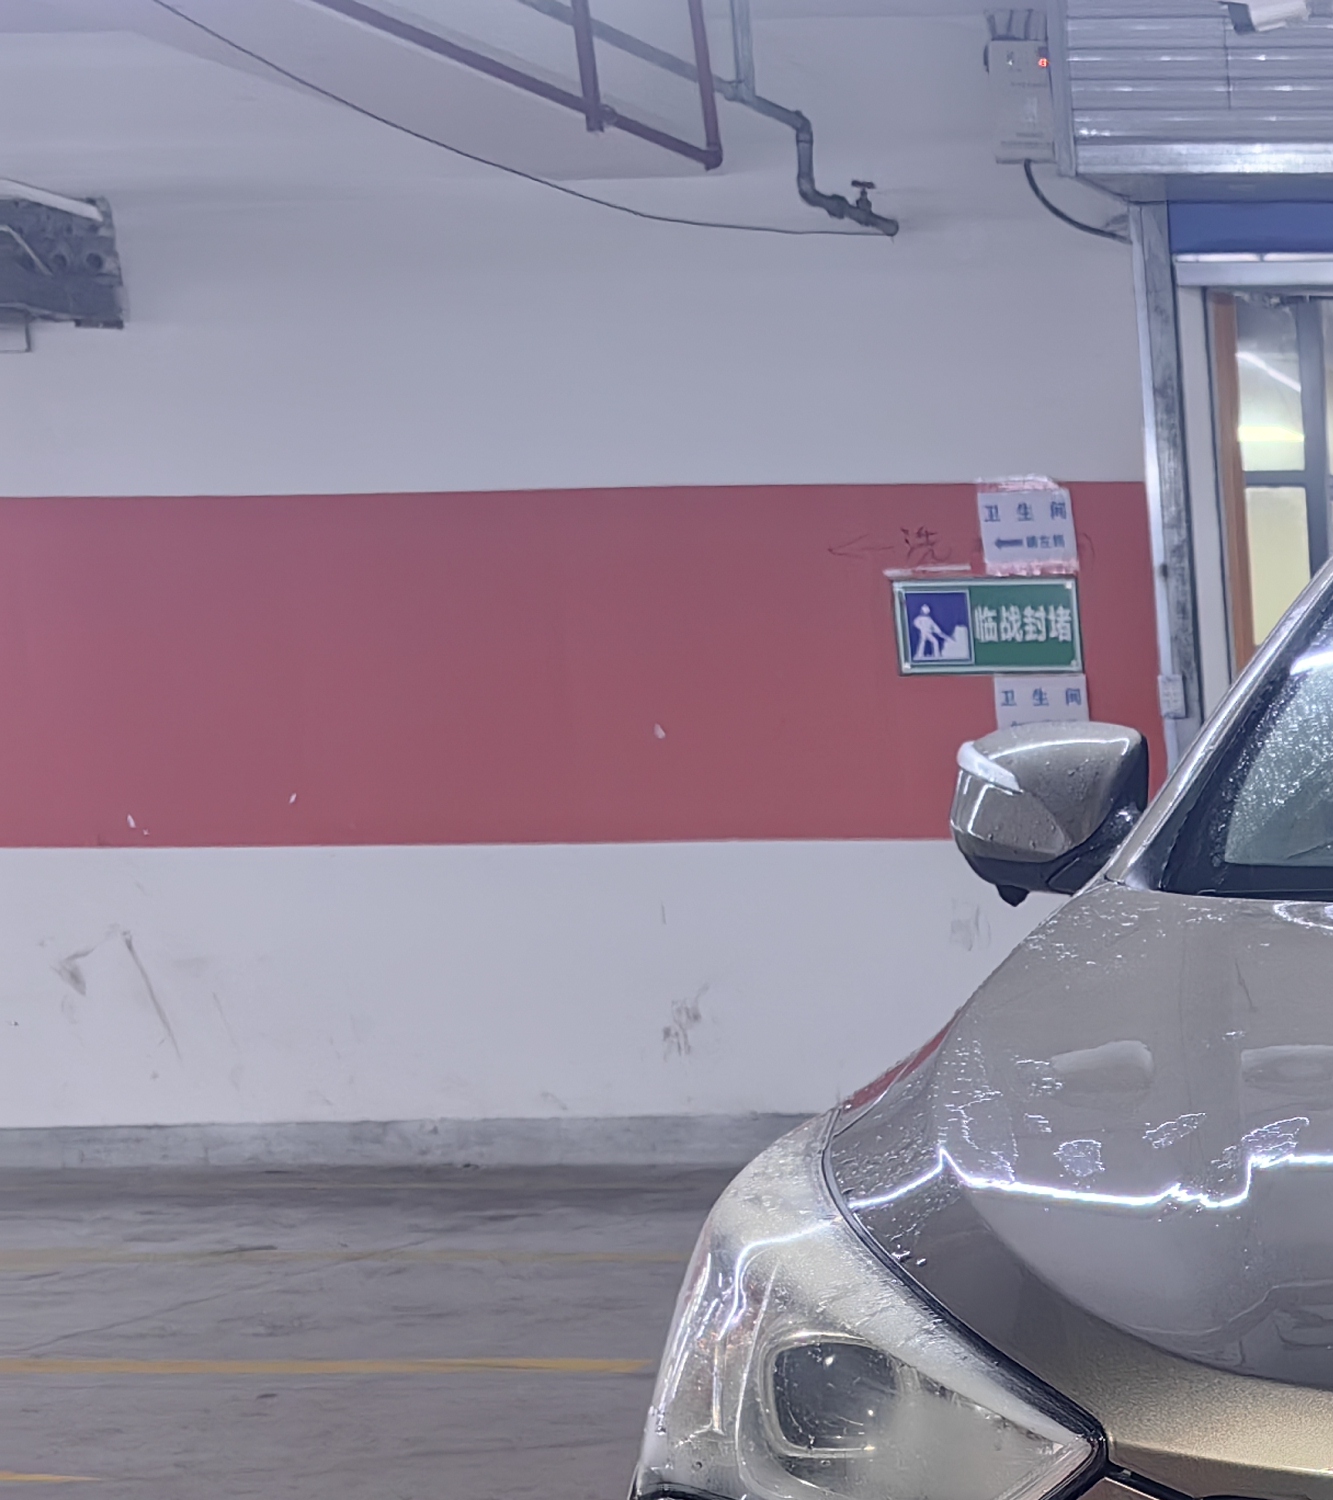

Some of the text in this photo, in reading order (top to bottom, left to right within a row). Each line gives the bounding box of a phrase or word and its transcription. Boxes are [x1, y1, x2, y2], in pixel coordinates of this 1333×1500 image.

[984, 501, 1067, 522] 卫生间
[974, 604, 1073, 642] 临战封堵
[1001, 687, 1082, 707] 卫生间
